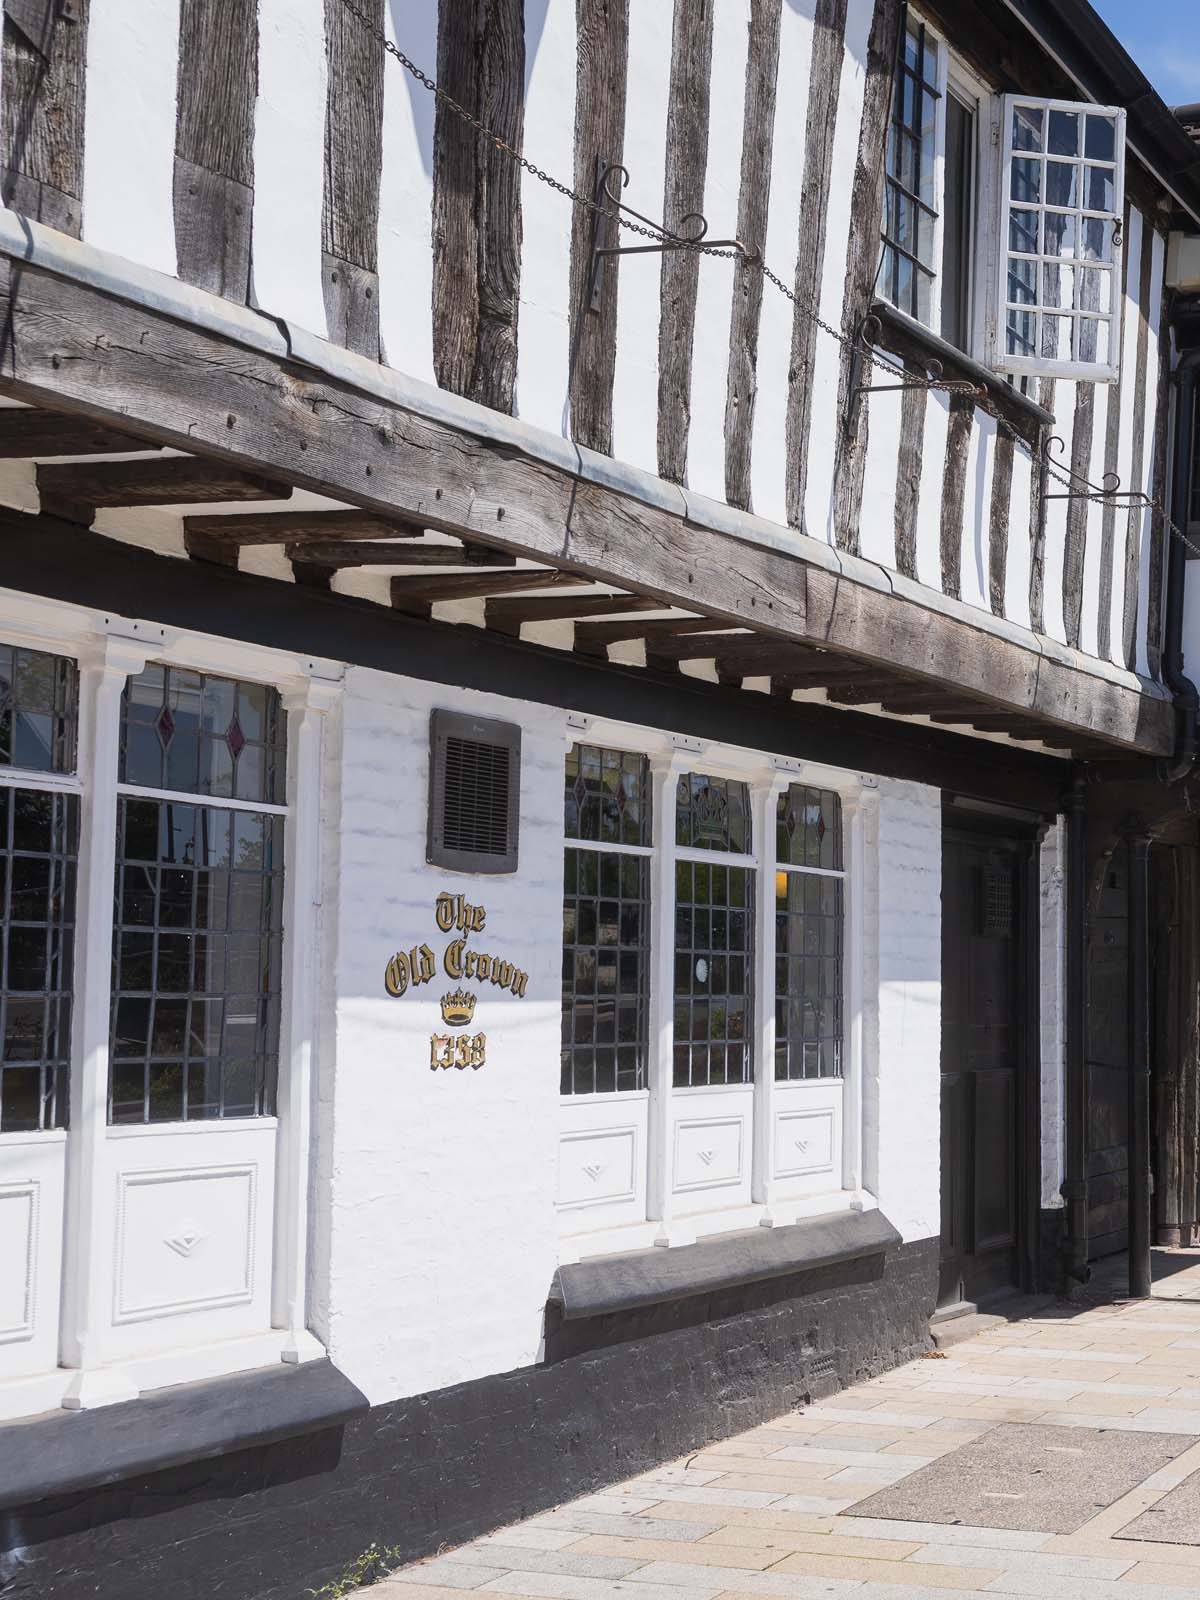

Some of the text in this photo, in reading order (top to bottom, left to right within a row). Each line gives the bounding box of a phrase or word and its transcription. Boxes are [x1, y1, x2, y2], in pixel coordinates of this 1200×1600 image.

[436, 891, 487, 939] The
[385, 938, 529, 999] Old Crown
